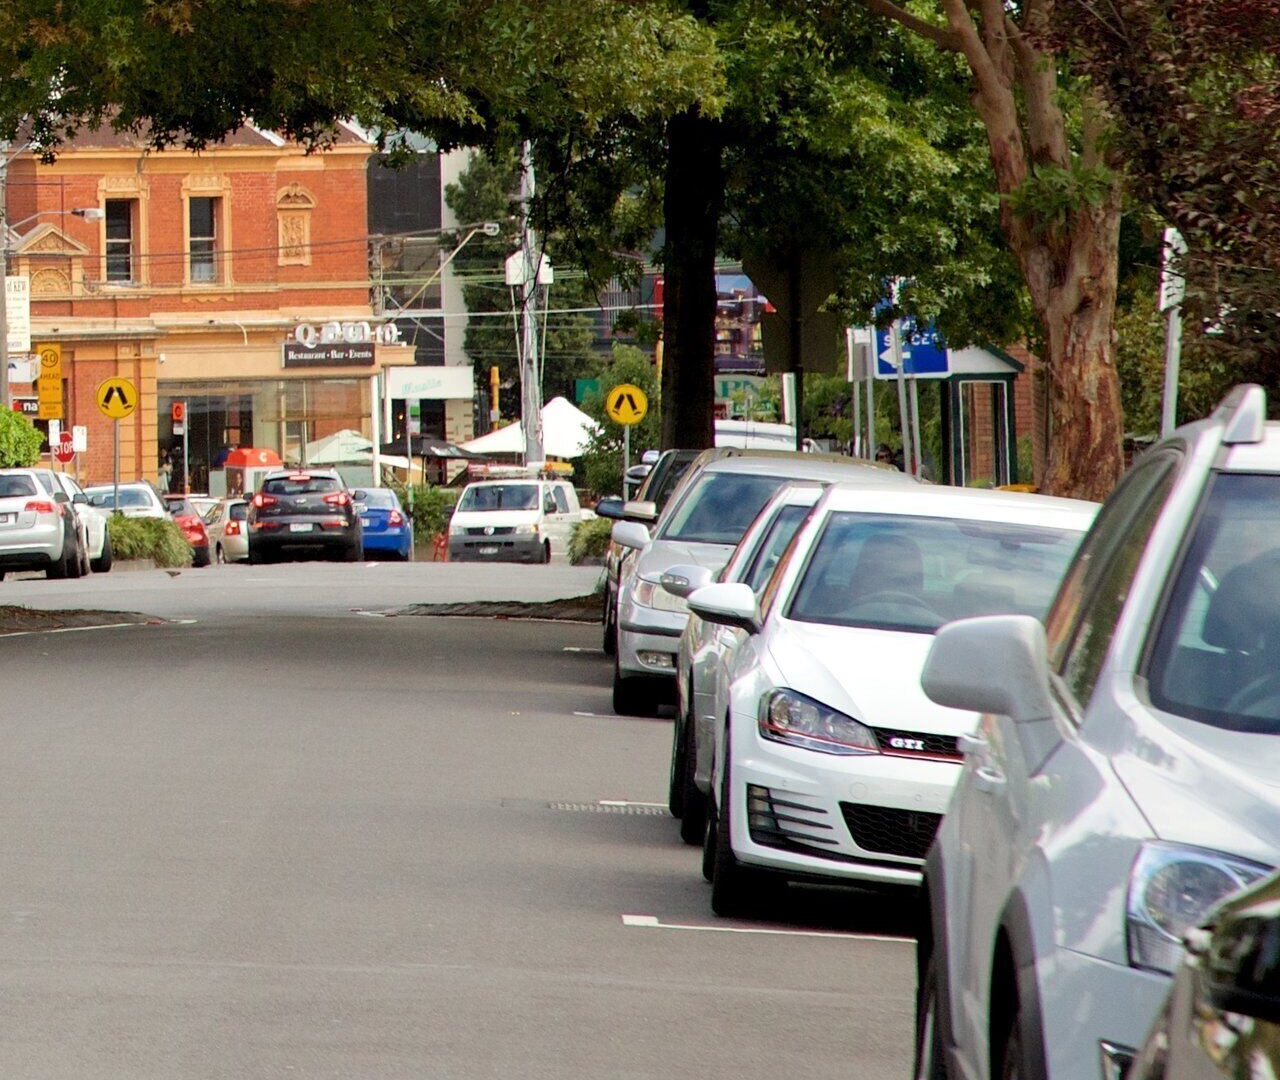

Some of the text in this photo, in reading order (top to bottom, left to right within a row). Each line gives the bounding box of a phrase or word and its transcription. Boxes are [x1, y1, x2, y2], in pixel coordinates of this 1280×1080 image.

[42, 354, 56, 363] 40
[288, 349, 372, 360] Restaurant Bar Events
[23, 401, 38, 411] na
[890, 738, 925, 750] GTI
